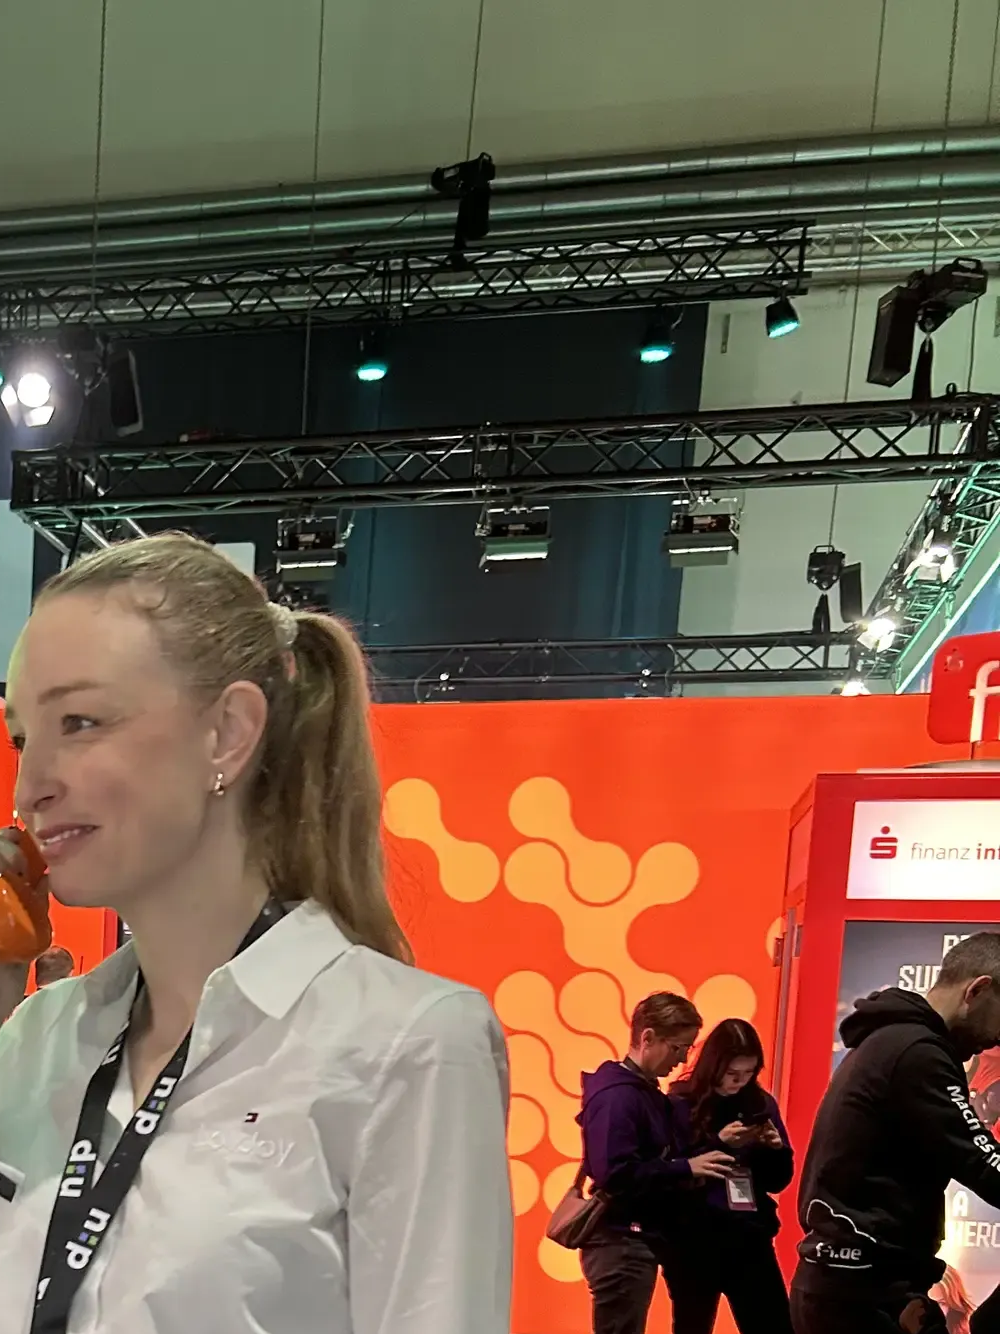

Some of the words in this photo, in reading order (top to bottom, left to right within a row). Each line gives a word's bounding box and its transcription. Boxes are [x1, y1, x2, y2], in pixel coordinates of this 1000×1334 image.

[910, 842, 970, 860] finanz
[134, 1077, 178, 1135] d:u
[947, 1085, 981, 1131] Mach
[973, 1134, 996, 1154] es
[58, 1139, 97, 1198] d:u
[953, 1191, 969, 1217] A
[65, 1207, 112, 1269] d:u
